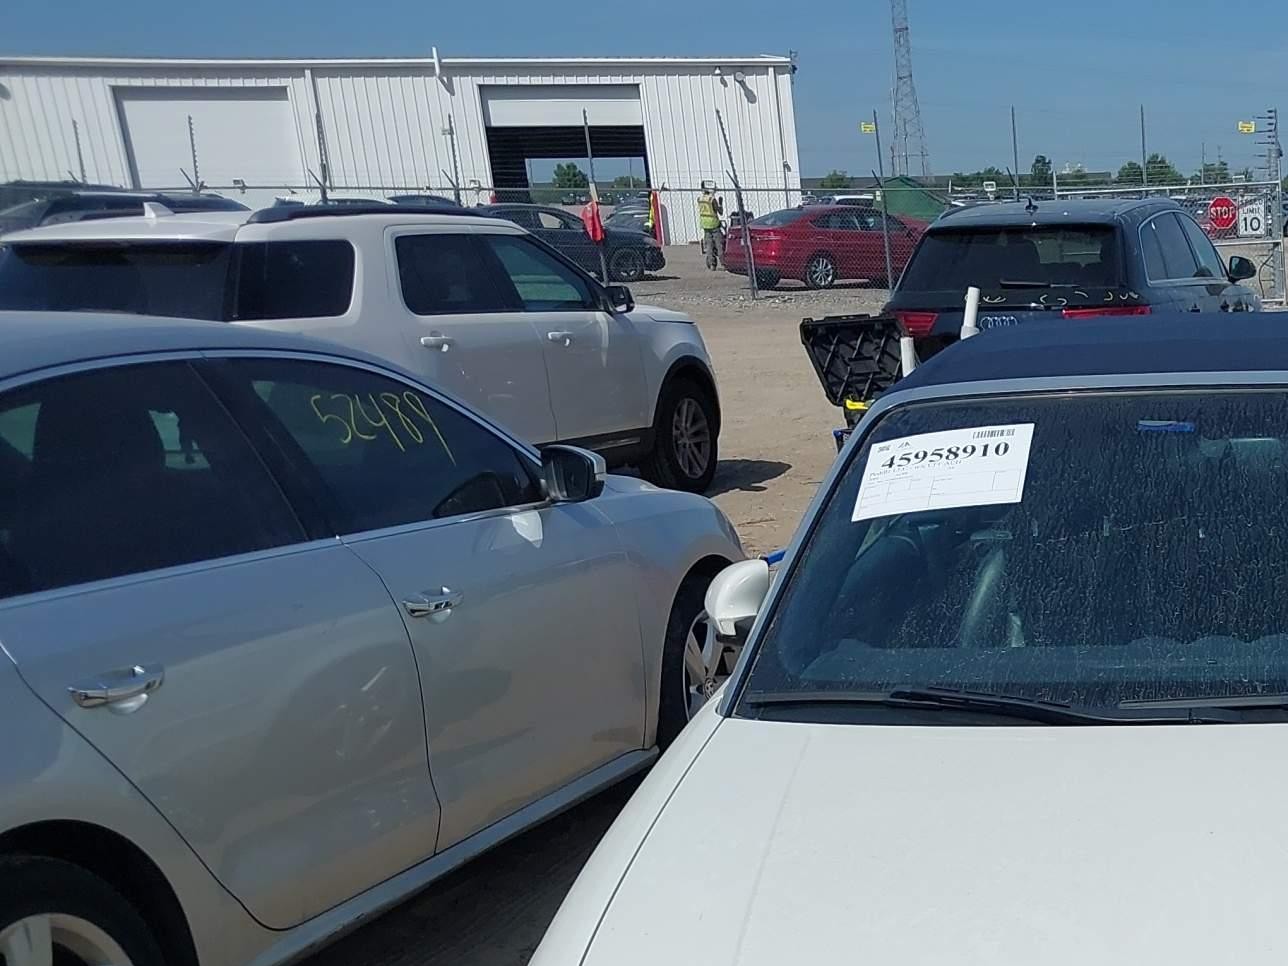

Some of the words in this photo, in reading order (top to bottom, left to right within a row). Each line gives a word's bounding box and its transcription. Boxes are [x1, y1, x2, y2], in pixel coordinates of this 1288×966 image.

[1210, 207, 1235, 218] STOP
[1244, 217, 1260, 232] 10
[310, 391, 456, 466] 52489
[881, 441, 1009, 469] 45958910
